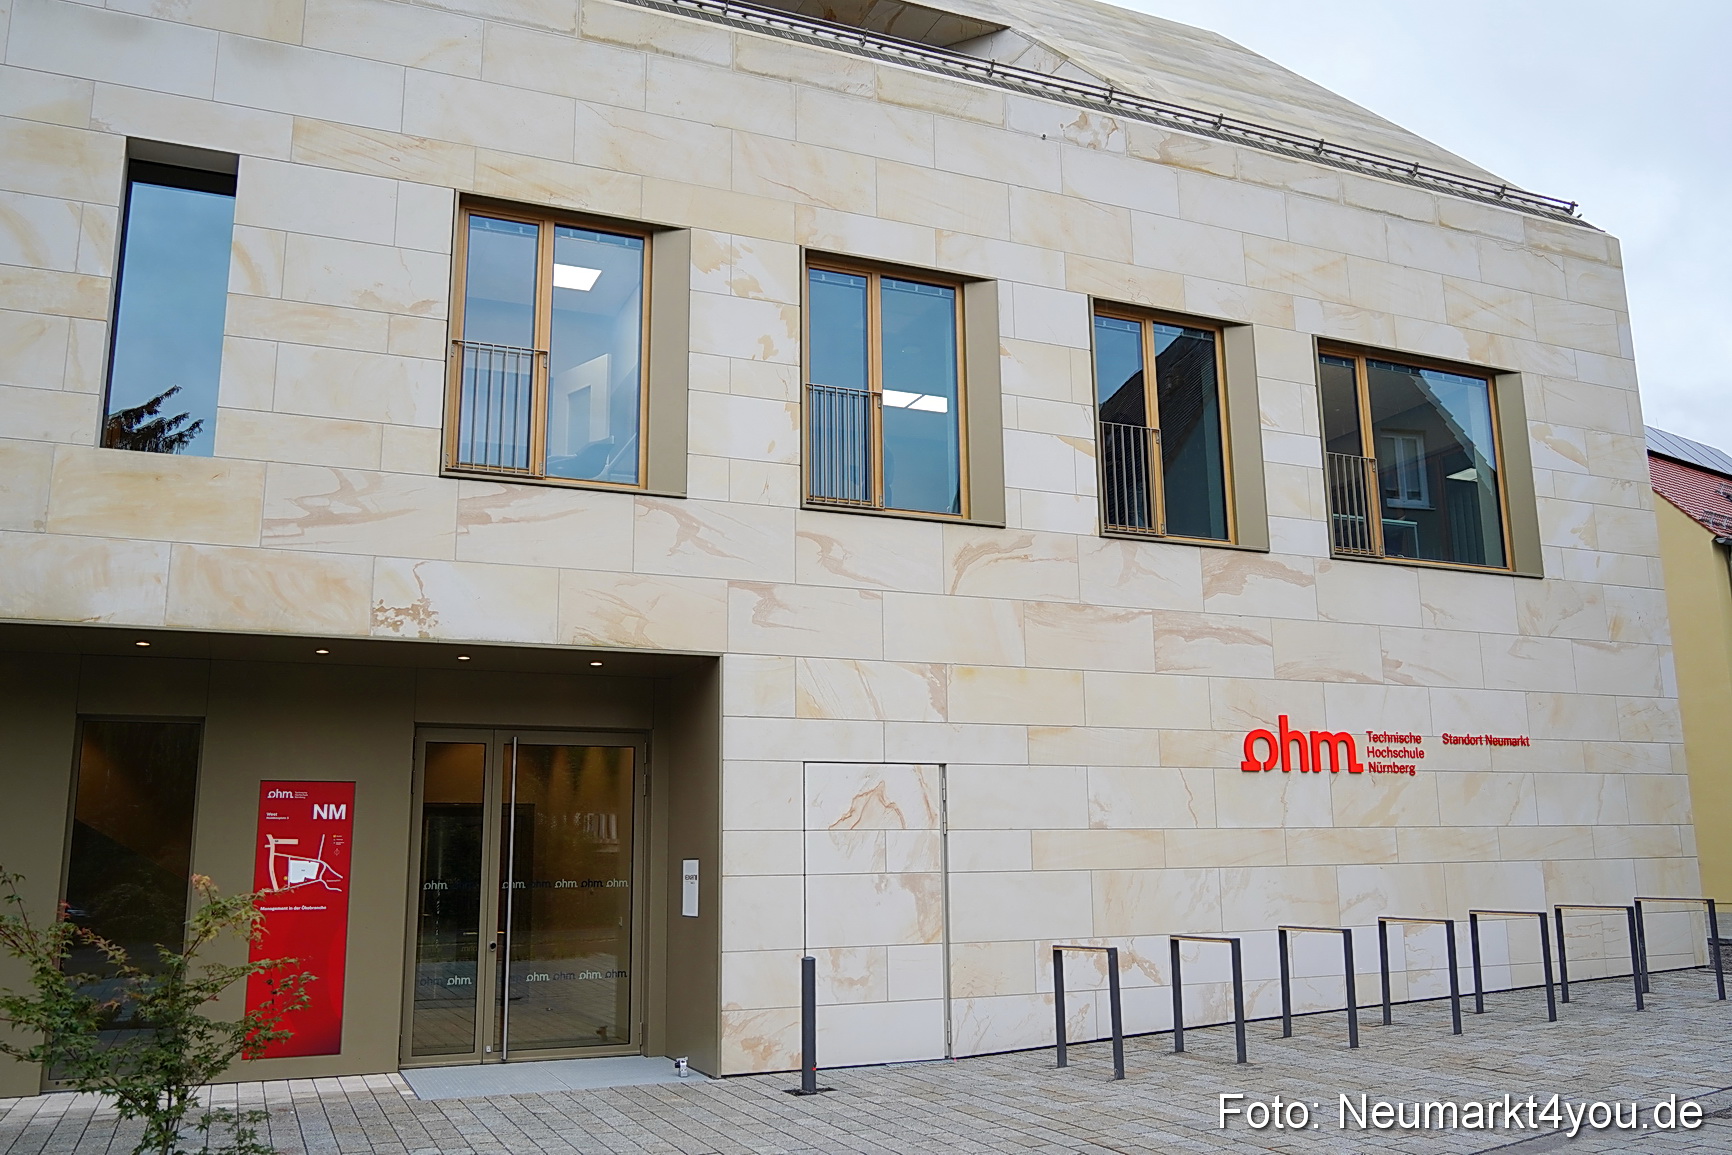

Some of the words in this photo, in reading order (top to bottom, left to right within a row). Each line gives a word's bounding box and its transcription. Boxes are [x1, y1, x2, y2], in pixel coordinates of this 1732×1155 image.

[1241, 715, 1364, 773] ohm
[1366, 731, 1422, 744] Technische
[1442, 733, 1483, 746] Standort
[1486, 735, 1530, 747] Neumarkt
[1367, 746, 1425, 759] Hochschule
[1368, 761, 1416, 776] Nürnberg
[268, 789, 294, 798] ohm
[313, 804, 346, 820] NM
[423, 879, 449, 890] ohm
[554, 878, 578, 888] ohm
[580, 878, 604, 888] ohm
[606, 878, 629, 888] ohm
[447, 975, 472, 986] ohm
[525, 971, 550, 982] ohm
[552, 971, 576, 981] ohm
[578, 969, 602, 980] ohm
[604, 969, 628, 979] ohm
